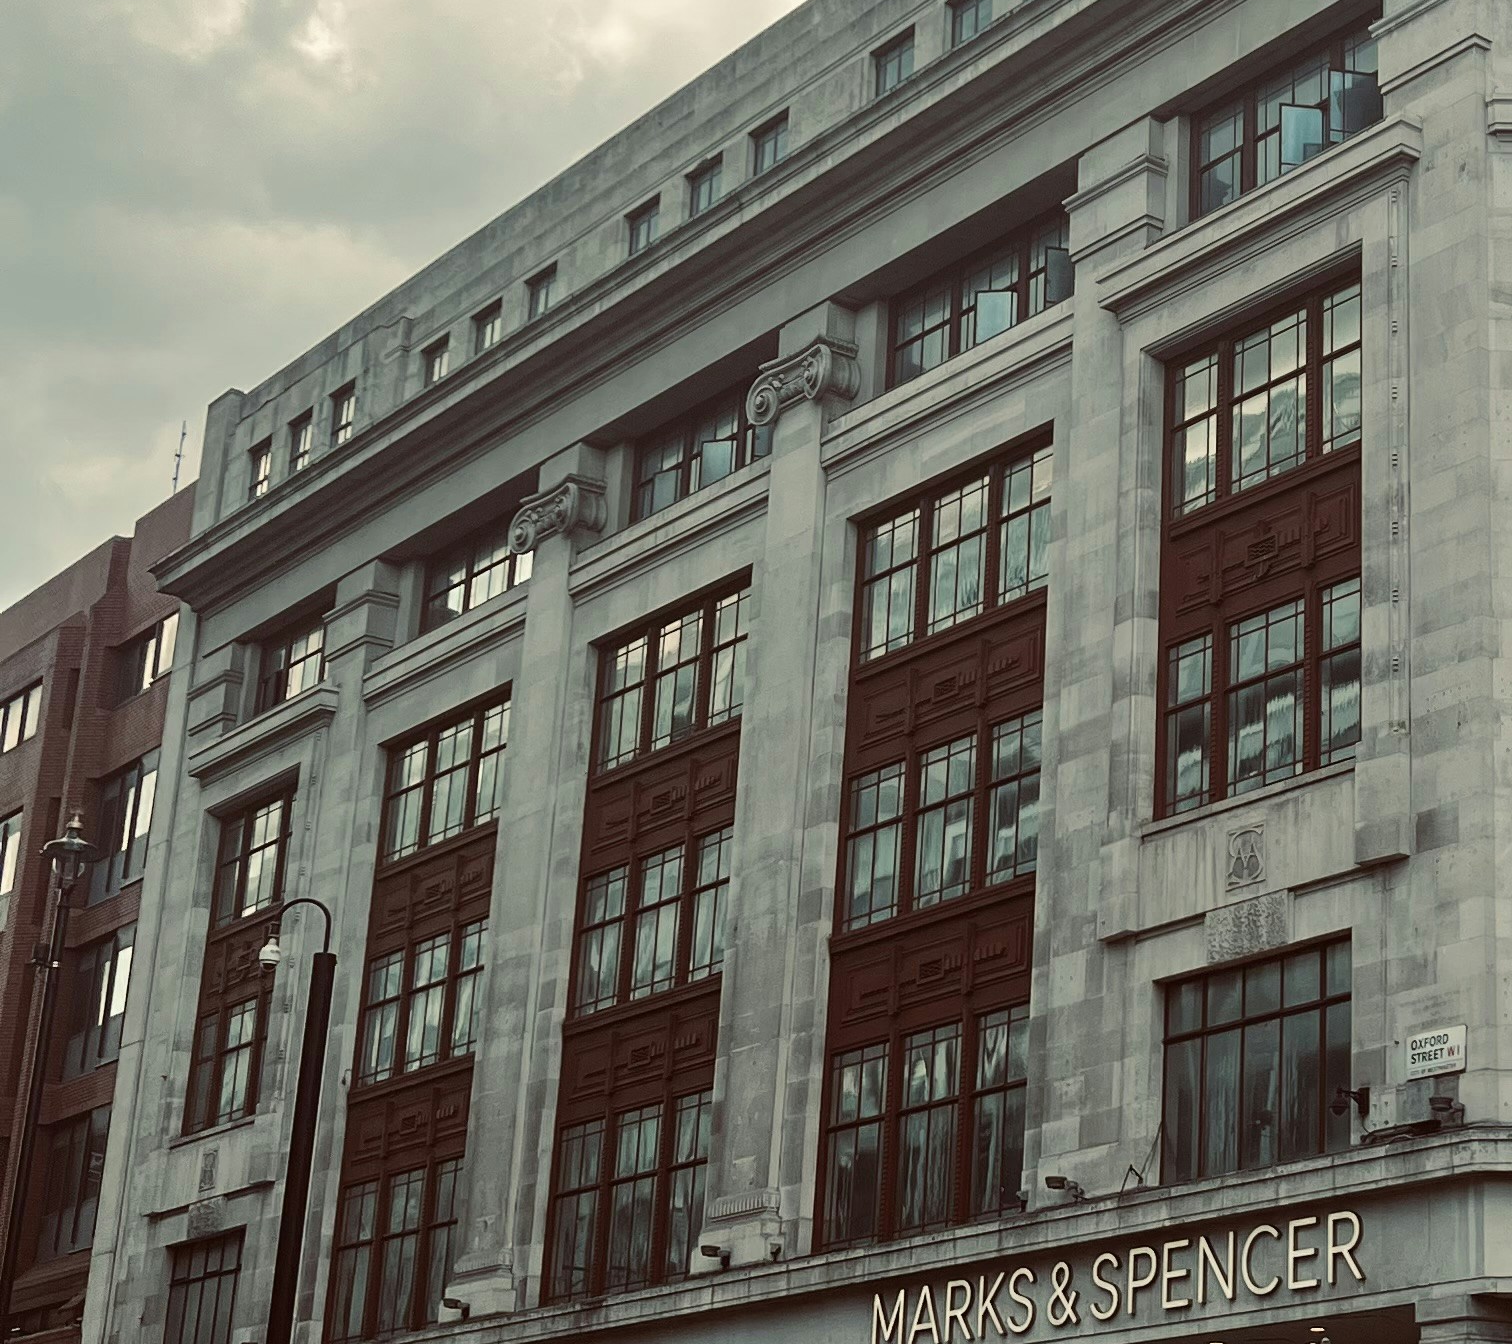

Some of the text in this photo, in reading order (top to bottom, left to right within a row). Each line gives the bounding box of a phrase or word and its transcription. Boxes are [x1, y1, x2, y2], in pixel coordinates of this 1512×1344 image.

[1411, 1034, 1449, 1050] OXFORD
[1411, 1048, 1444, 1064] STREET
[1046, 1261, 1080, 1327] &
[1089, 1210, 1366, 1321] SPENCER
